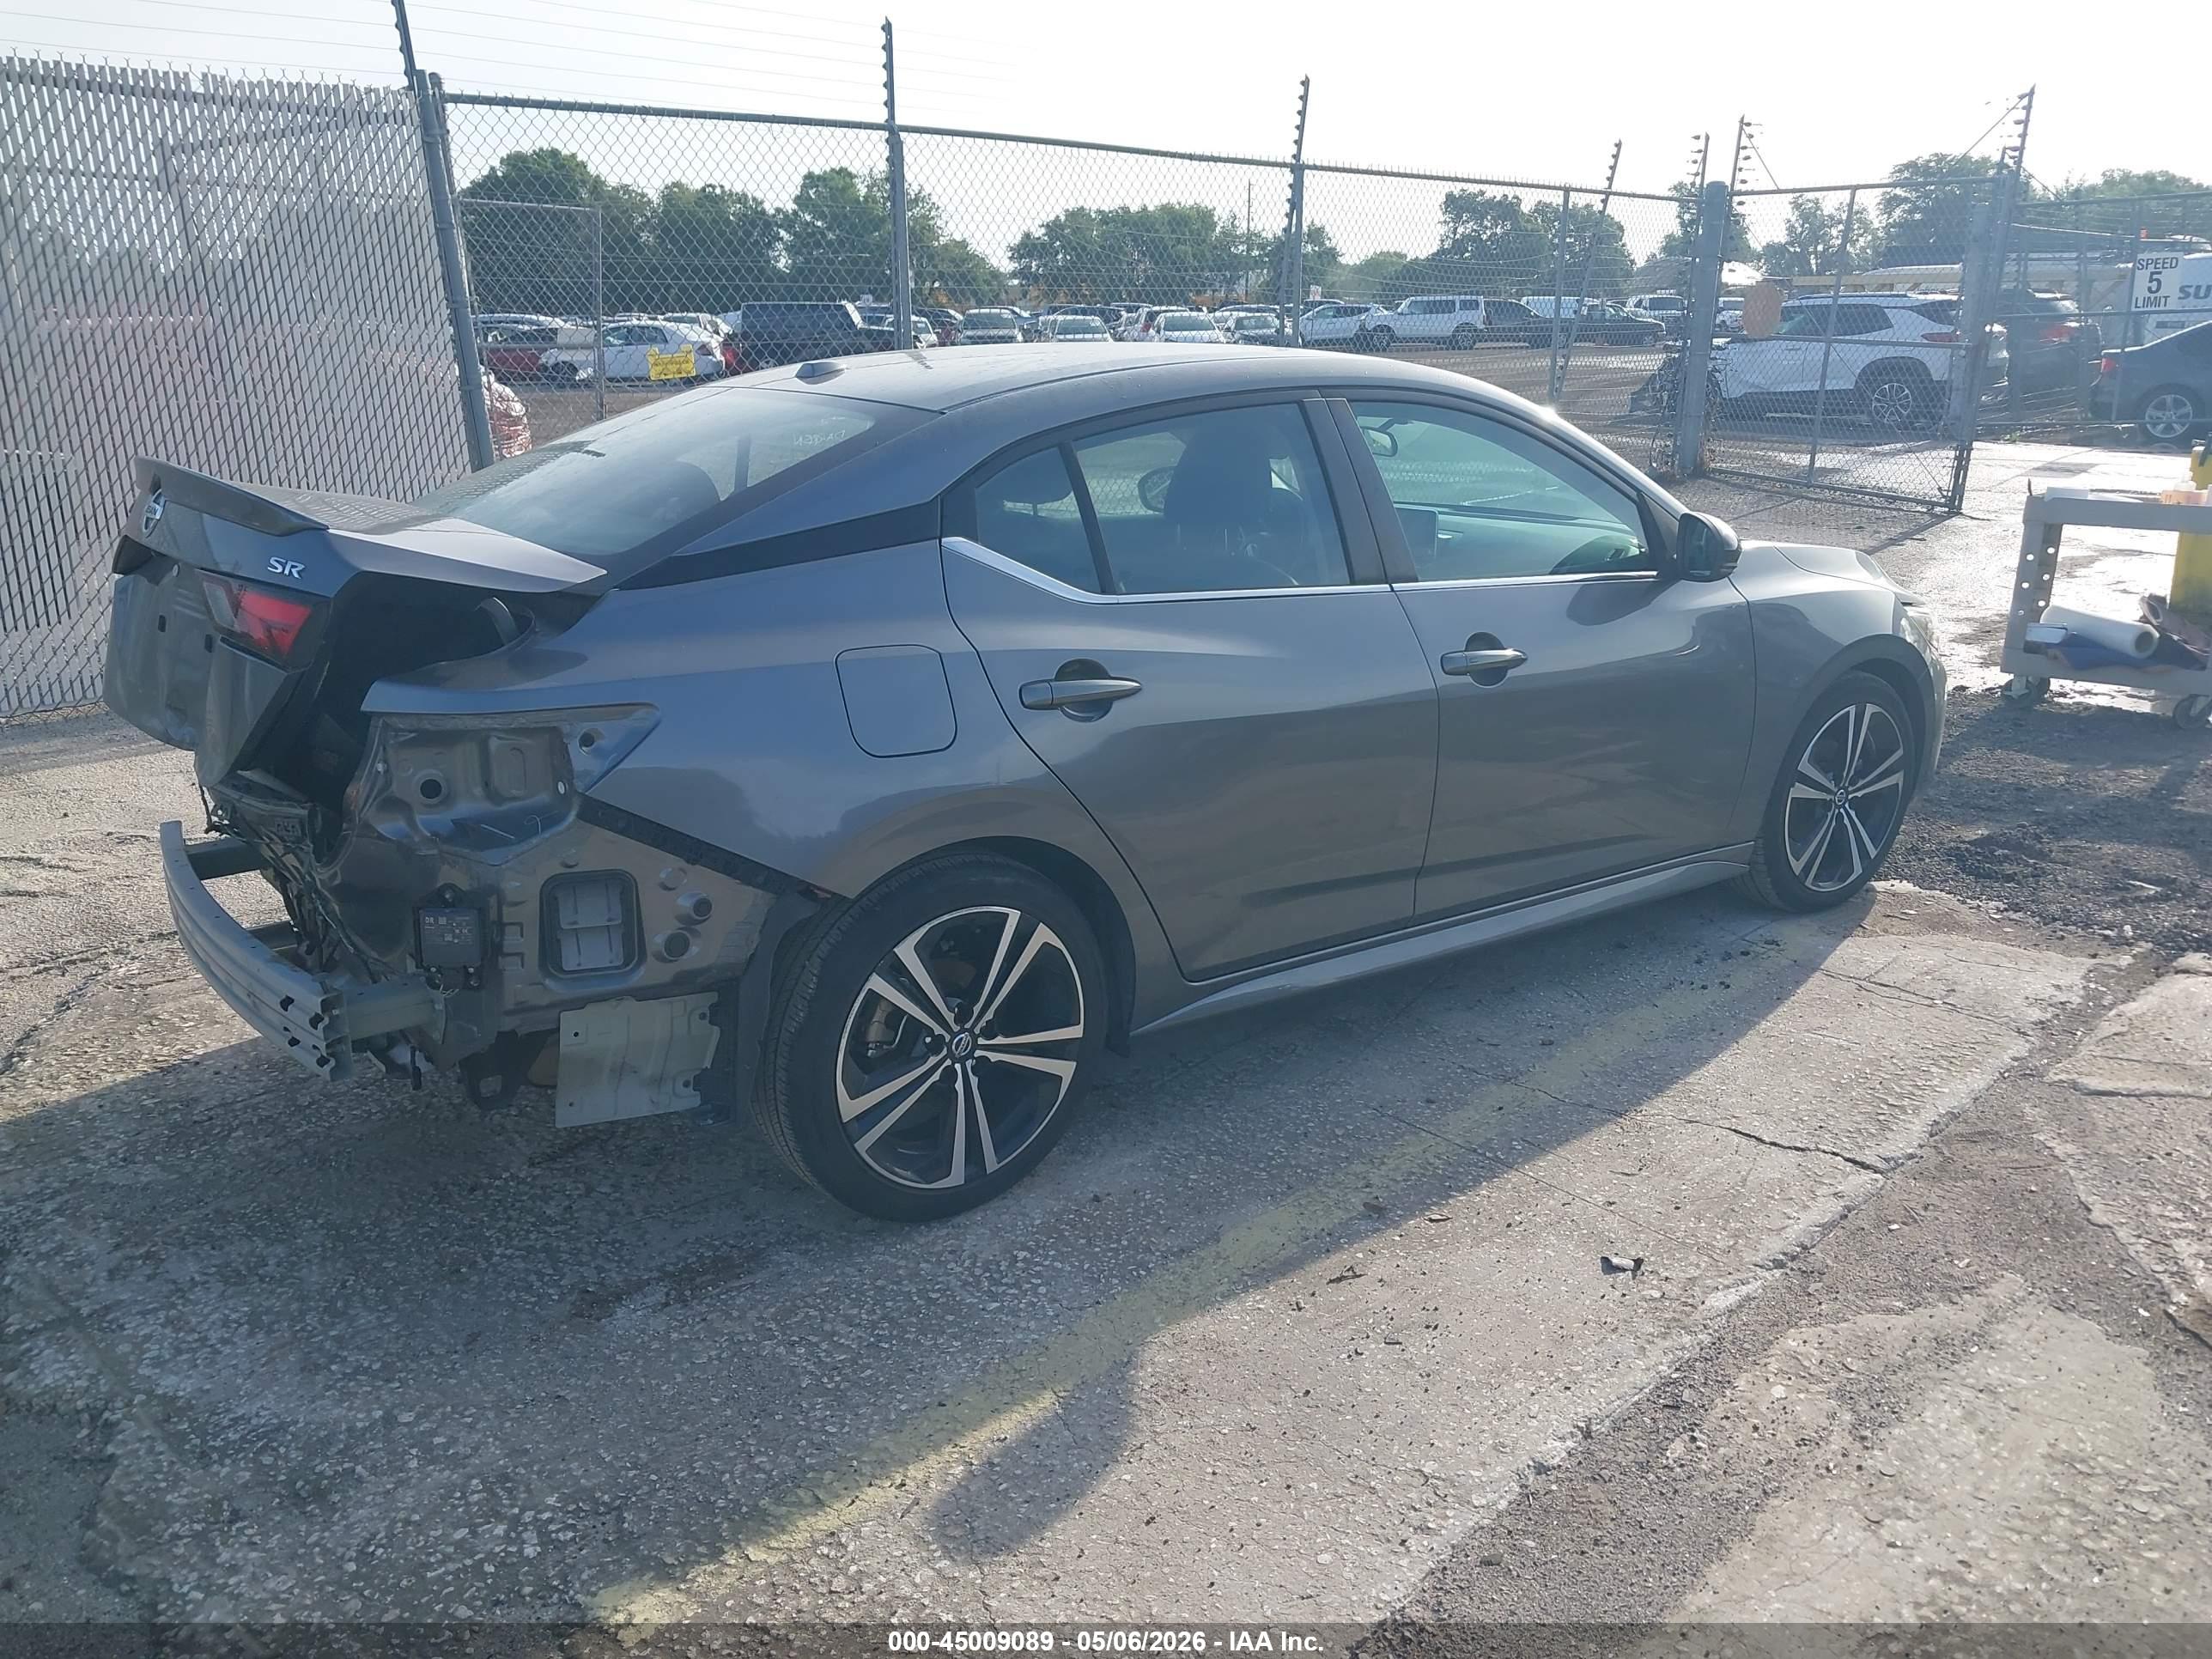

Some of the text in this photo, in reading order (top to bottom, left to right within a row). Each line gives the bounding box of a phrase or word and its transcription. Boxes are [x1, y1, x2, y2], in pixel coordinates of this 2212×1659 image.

[2136, 257, 2179, 270] SPEED
[2147, 270, 2163, 295] 5
[2134, 295, 2171, 309] LIMIT
[267, 556, 306, 580] SR
